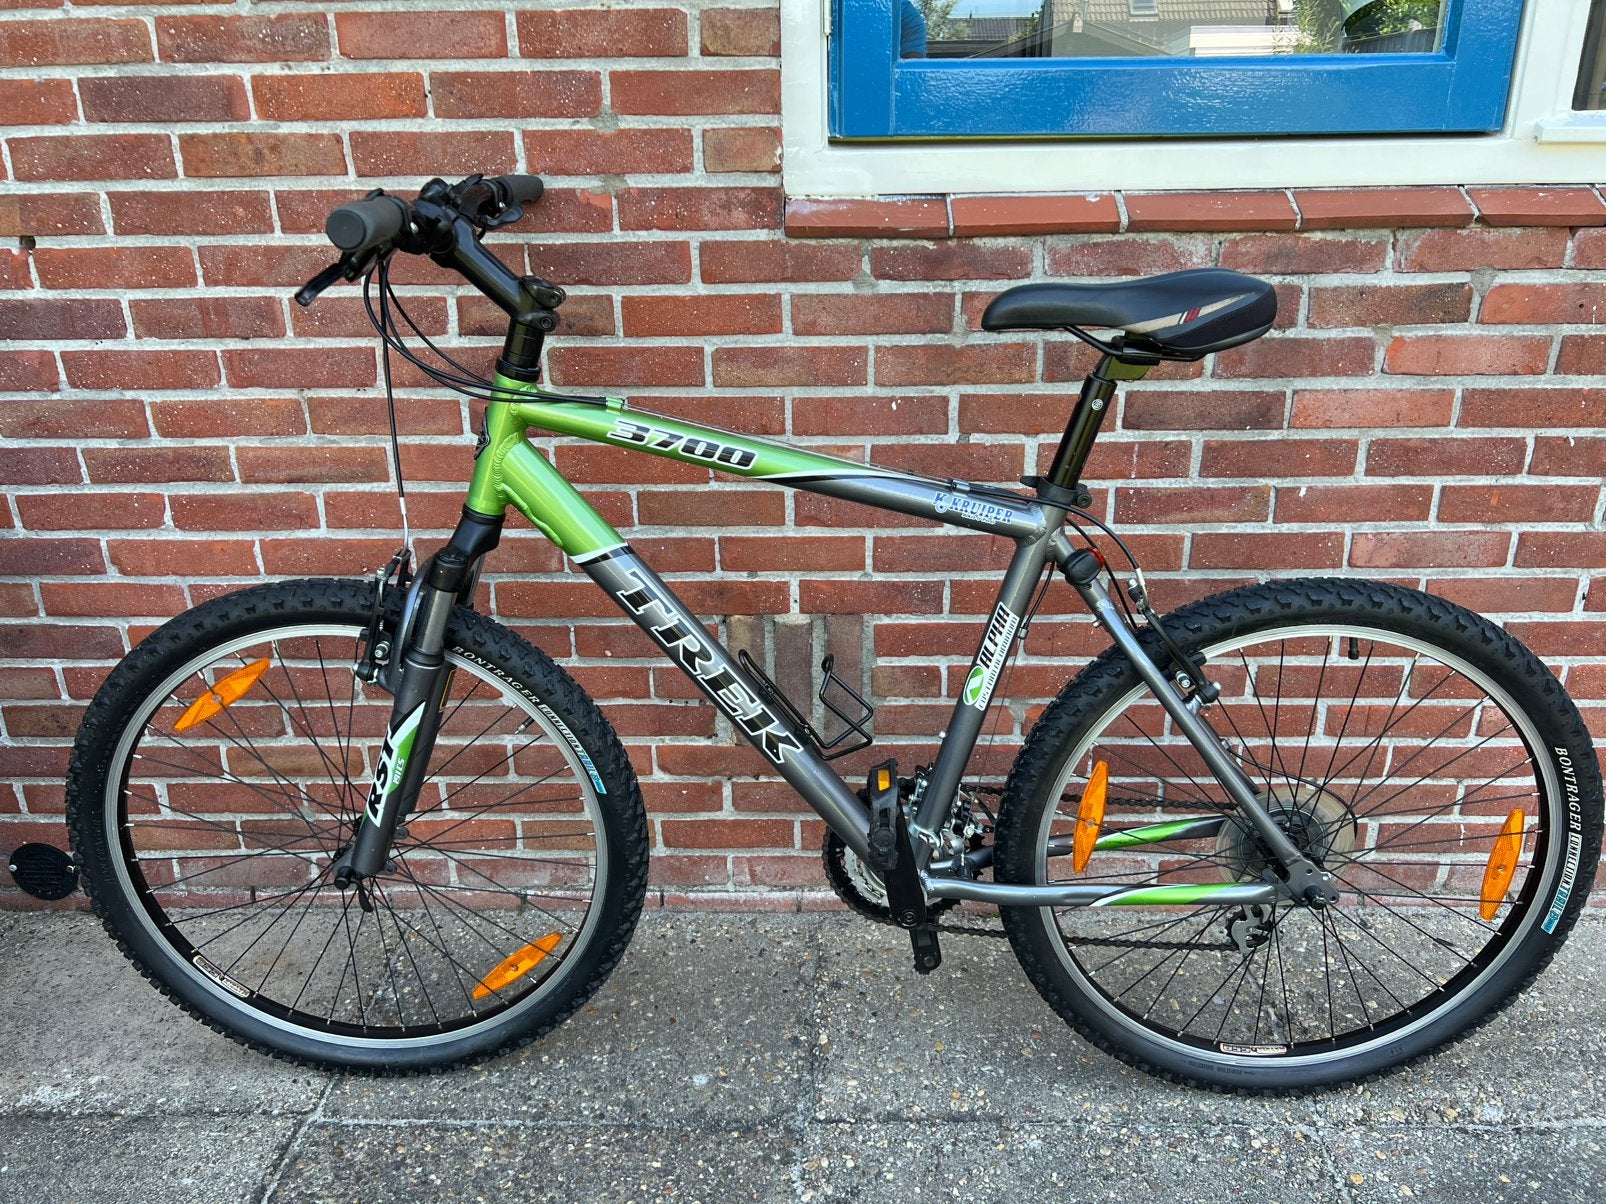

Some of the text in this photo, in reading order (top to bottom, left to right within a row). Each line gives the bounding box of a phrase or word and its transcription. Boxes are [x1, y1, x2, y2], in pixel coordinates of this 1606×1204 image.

[606, 418, 759, 470] 3700
[949, 497, 1014, 523] KRUIPER
[616, 568, 804, 764] TREK
[978, 603, 1011, 670] ALPHA
[452, 646, 541, 703] BONTRAGER
[541, 704, 581, 750] CONNECTION
[368, 730, 394, 820] RST
[1555, 746, 1582, 833] BONTRAGER
[1560, 834, 1582, 888] CONNECTION
